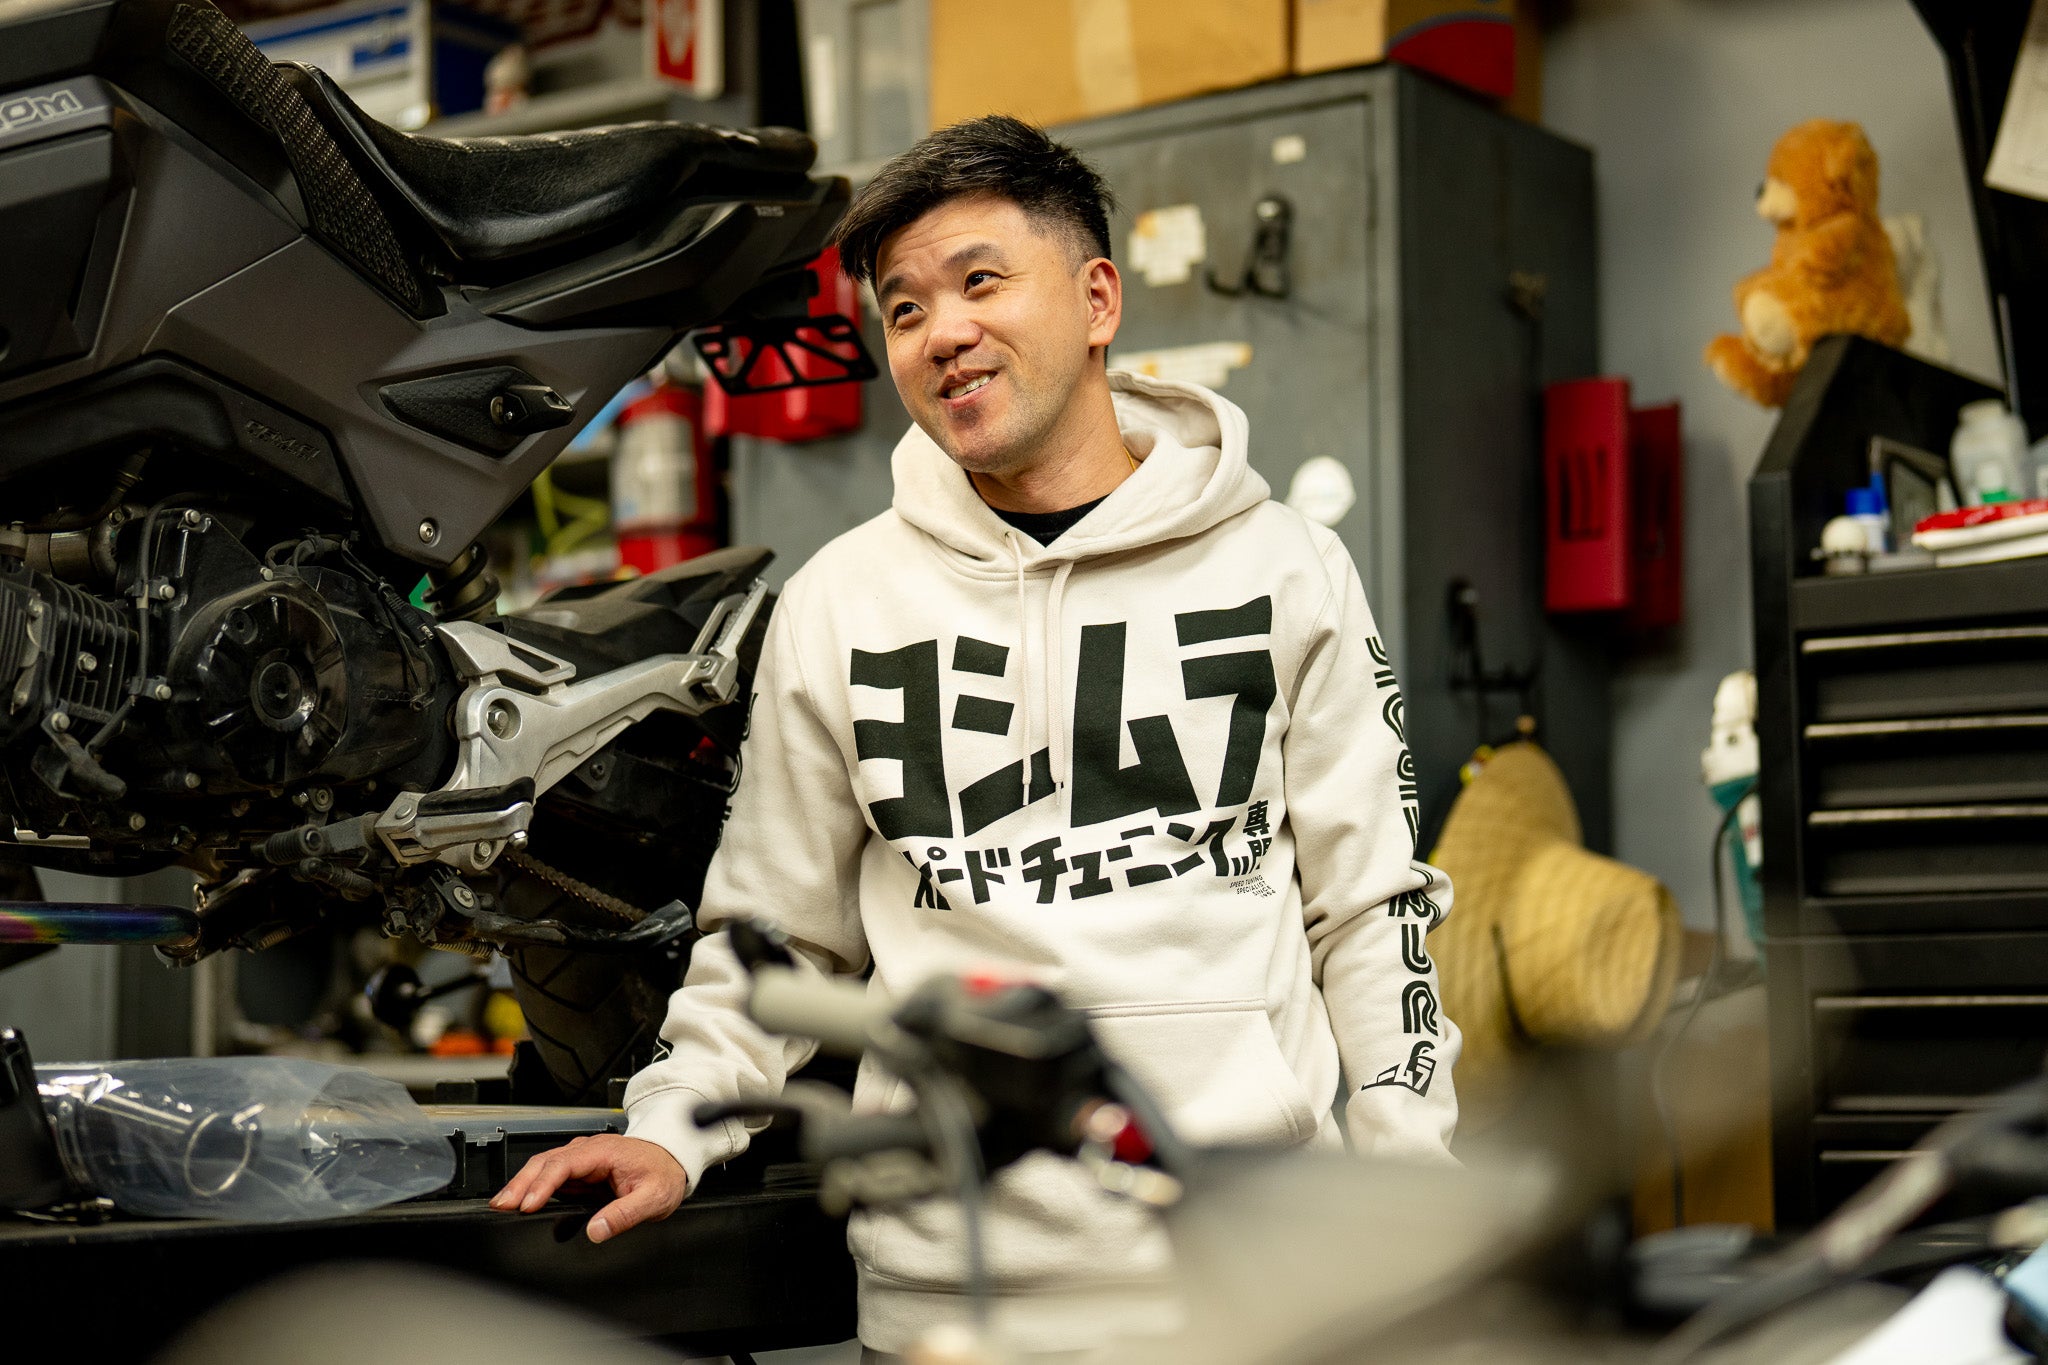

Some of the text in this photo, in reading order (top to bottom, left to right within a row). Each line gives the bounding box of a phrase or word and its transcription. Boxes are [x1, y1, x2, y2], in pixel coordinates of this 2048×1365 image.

[0, 89, 83, 128] OM
[361, 687, 413, 703] HOND
[850, 595, 1277, 841] ヨシムラ
[1230, 875, 1263, 888] SPEED TUNING
[1237, 881, 1266, 894] SPECIALIST
